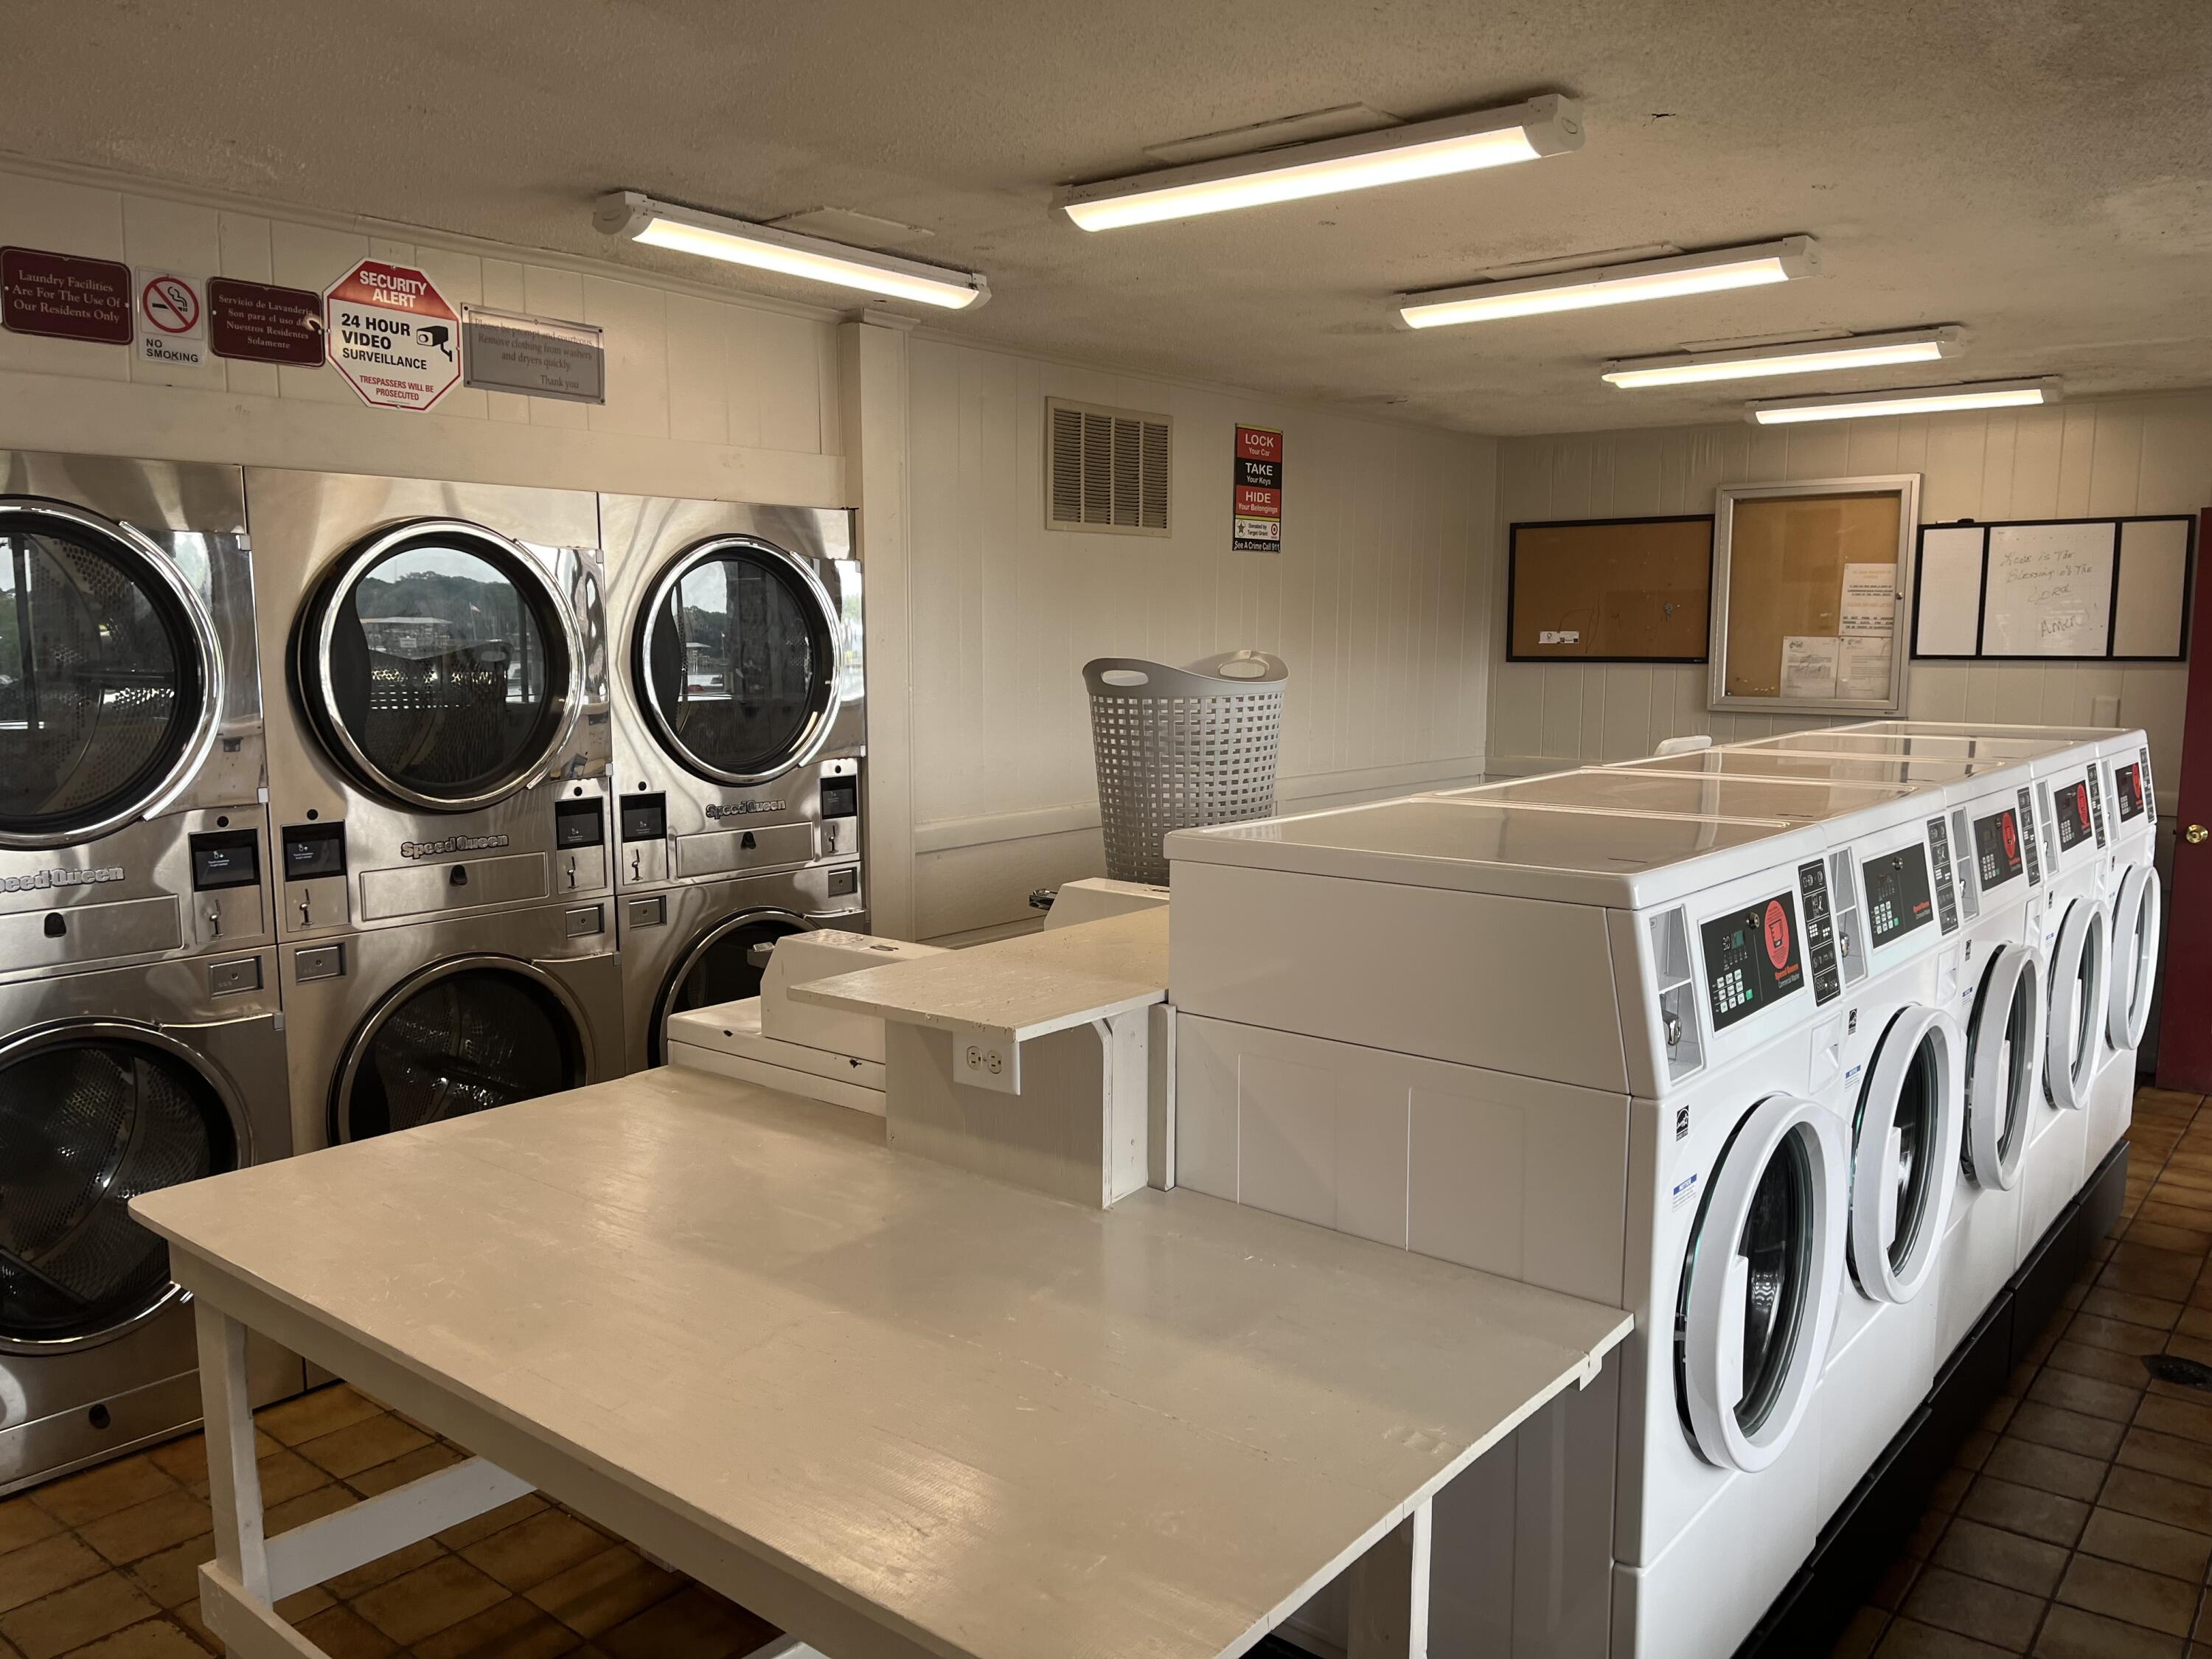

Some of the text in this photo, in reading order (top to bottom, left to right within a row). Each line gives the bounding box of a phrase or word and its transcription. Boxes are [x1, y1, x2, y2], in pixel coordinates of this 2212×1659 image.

[18, 269, 114, 293] Laundry Facilities
[359, 271, 427, 296] SECURITY
[13, 285, 122, 308] Are For The Use Of
[218, 295, 253, 307] Servicio
[256, 300, 266, 309] de
[372, 288, 417, 308] ALERT
[14, 299, 119, 324] Our Residents Only
[228, 308, 244, 318] Son
[247, 313, 265, 322] para
[226, 321, 309, 340] Nuestros Residentes
[341, 313, 411, 336] 24 HOUR
[146, 338, 162, 348] NO
[247, 336, 291, 349] Solamente
[341, 330, 392, 350] VIDEO
[479, 333, 592, 361] Remove clothing from washers
[147, 348, 198, 363] SMOKING
[342, 347, 427, 370] SURVEILLANCE
[501, 352, 516, 361] and
[518, 352, 542, 366] dryers
[360, 375, 434, 393] TRESPASSERS WILL BE
[540, 375, 579, 390] Thank you
[376, 388, 420, 401] PROSECUTED
[1245, 434, 1274, 448] LOCK
[1248, 447, 1260, 456] Your
[1245, 462, 1273, 476] TAKE
[1247, 476, 1271, 487] Your Keys
[1245, 491, 1271, 504] HIDE
[1238, 503, 1278, 514] Your Belongings
[1234, 540, 1281, 552] See A Crime Call 911
[706, 799, 786, 820] Speed Queen
[400, 835, 509, 860] Speed Queen
[0, 866, 125, 894] eed Queen
